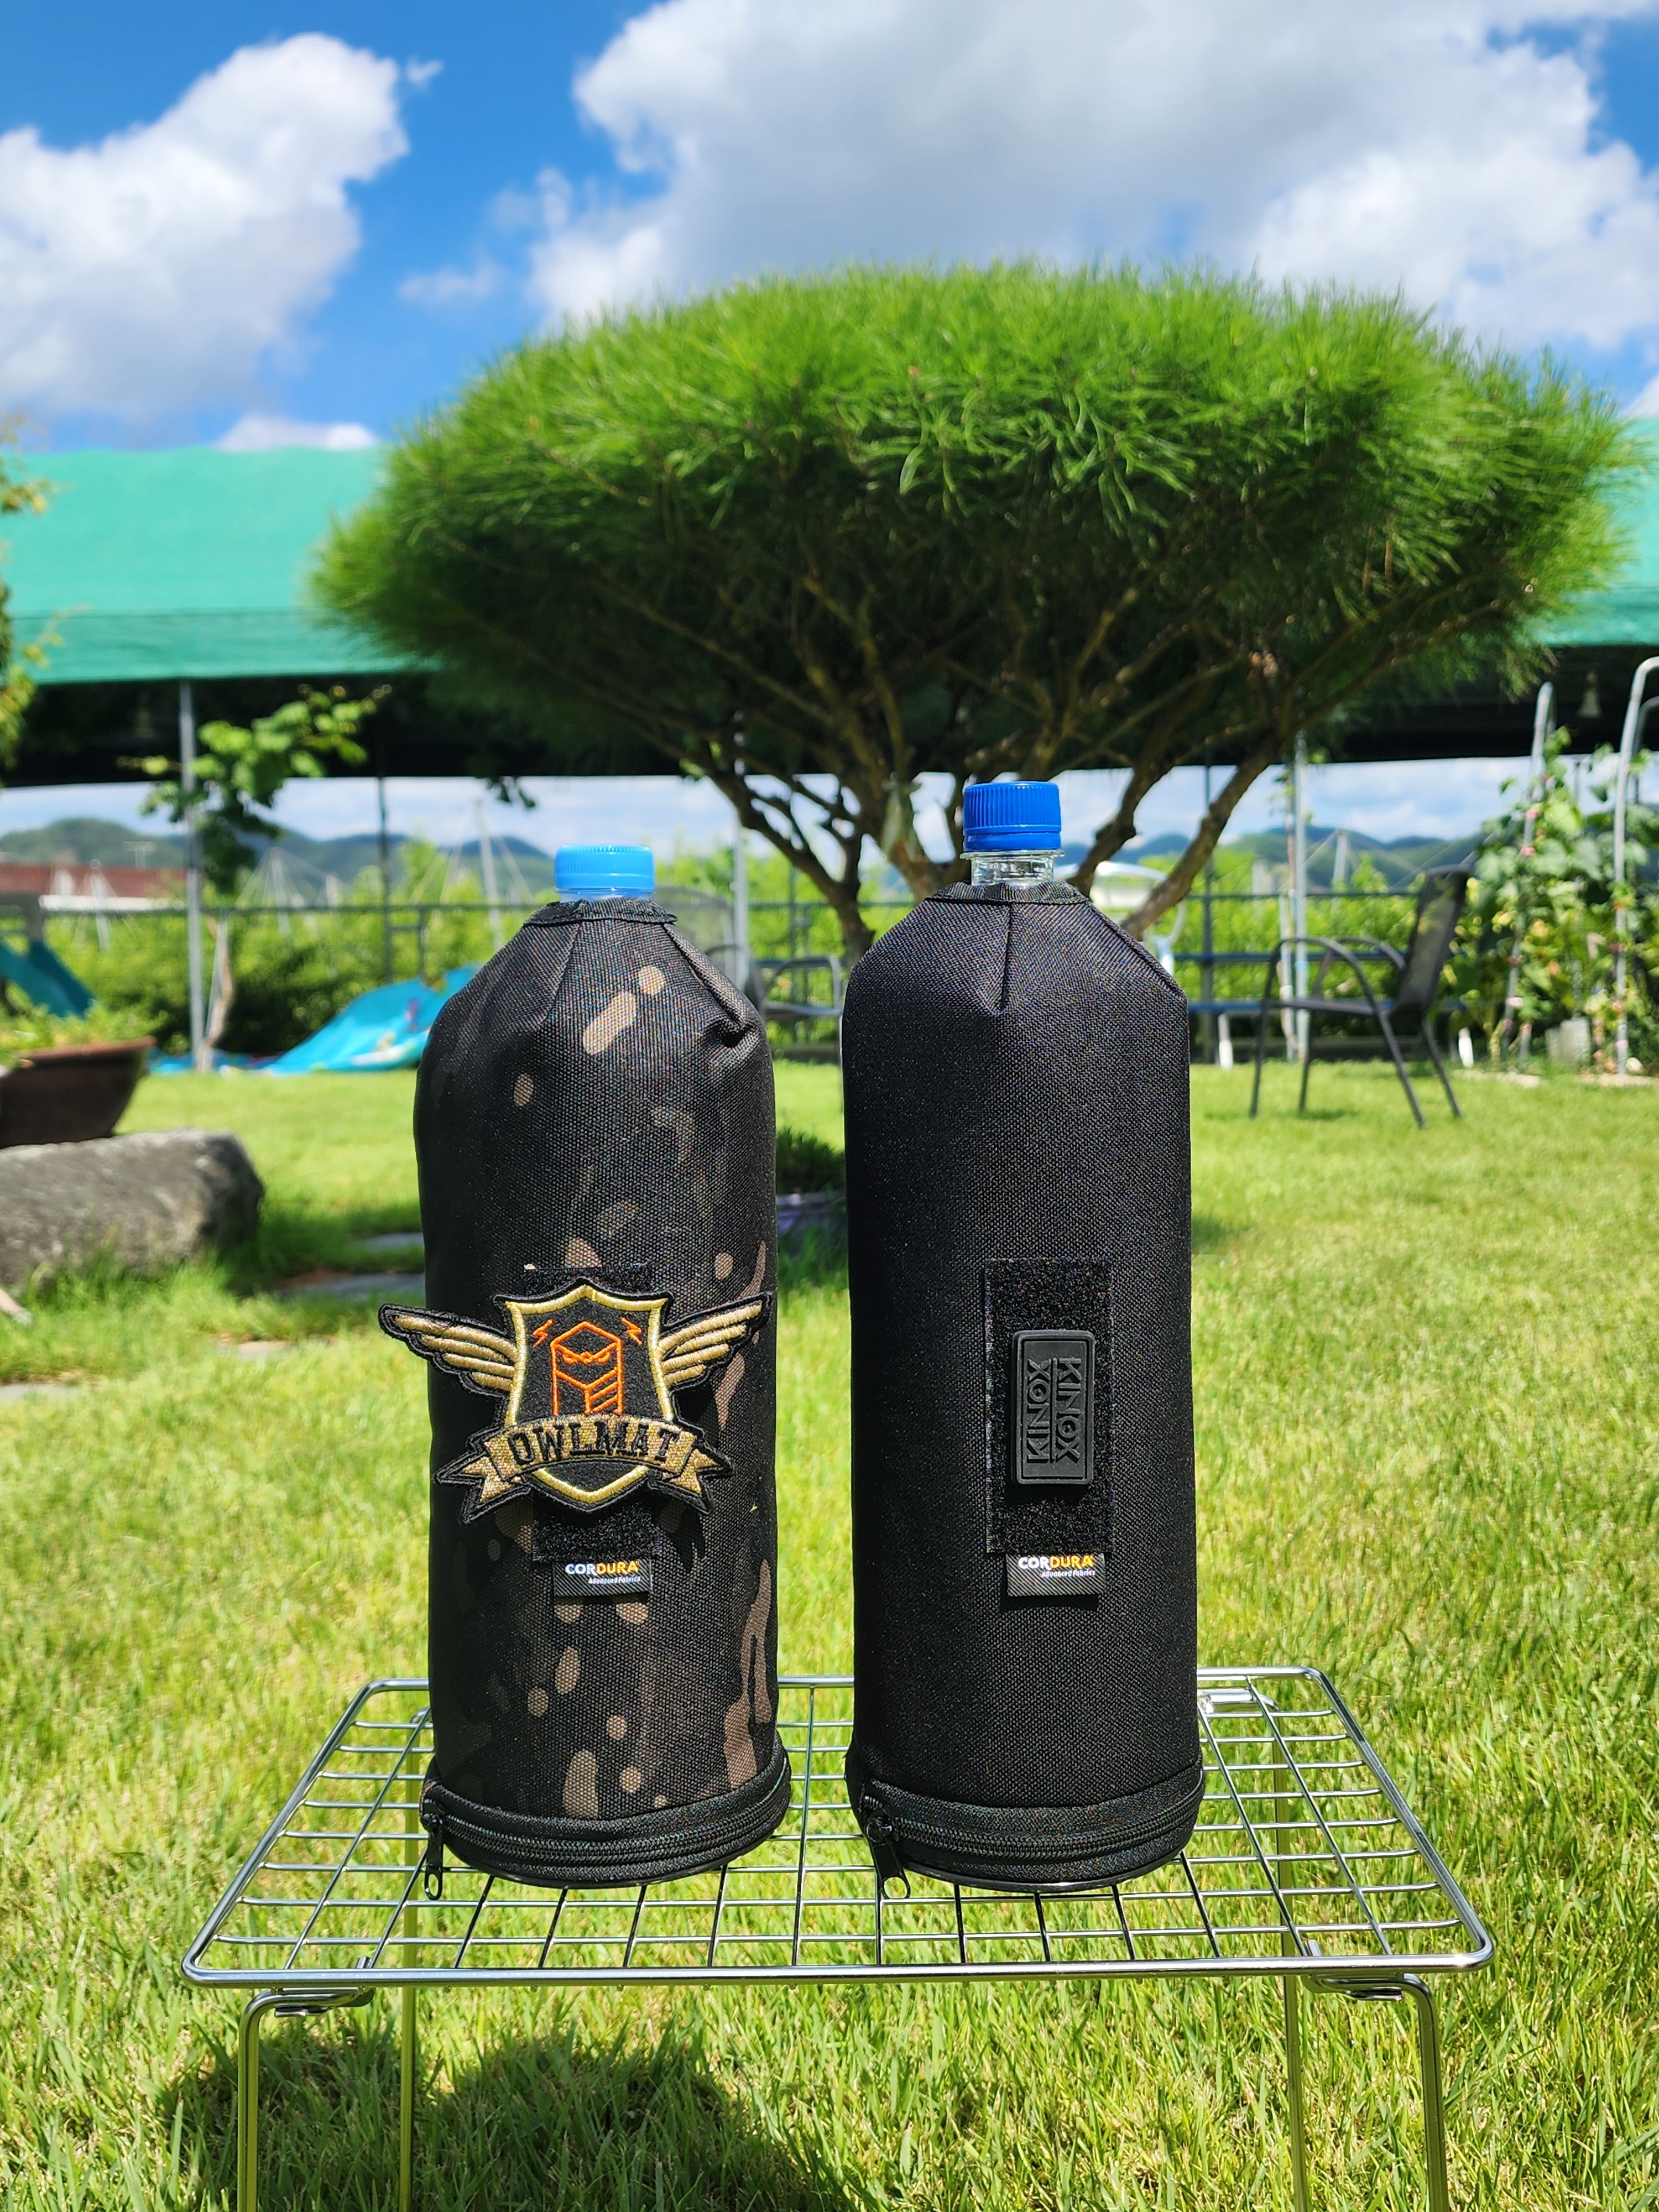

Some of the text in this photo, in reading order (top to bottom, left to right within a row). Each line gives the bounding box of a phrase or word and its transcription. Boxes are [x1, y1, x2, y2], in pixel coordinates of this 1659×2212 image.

[1027, 1358, 1051, 1460] KINOX
[1056, 1357, 1082, 1460] KINOX
[507, 1421, 681, 1465] OWLMAT
[564, 1561, 639, 1576] CORDURA
[1018, 1555, 1094, 1571] CORDURA
